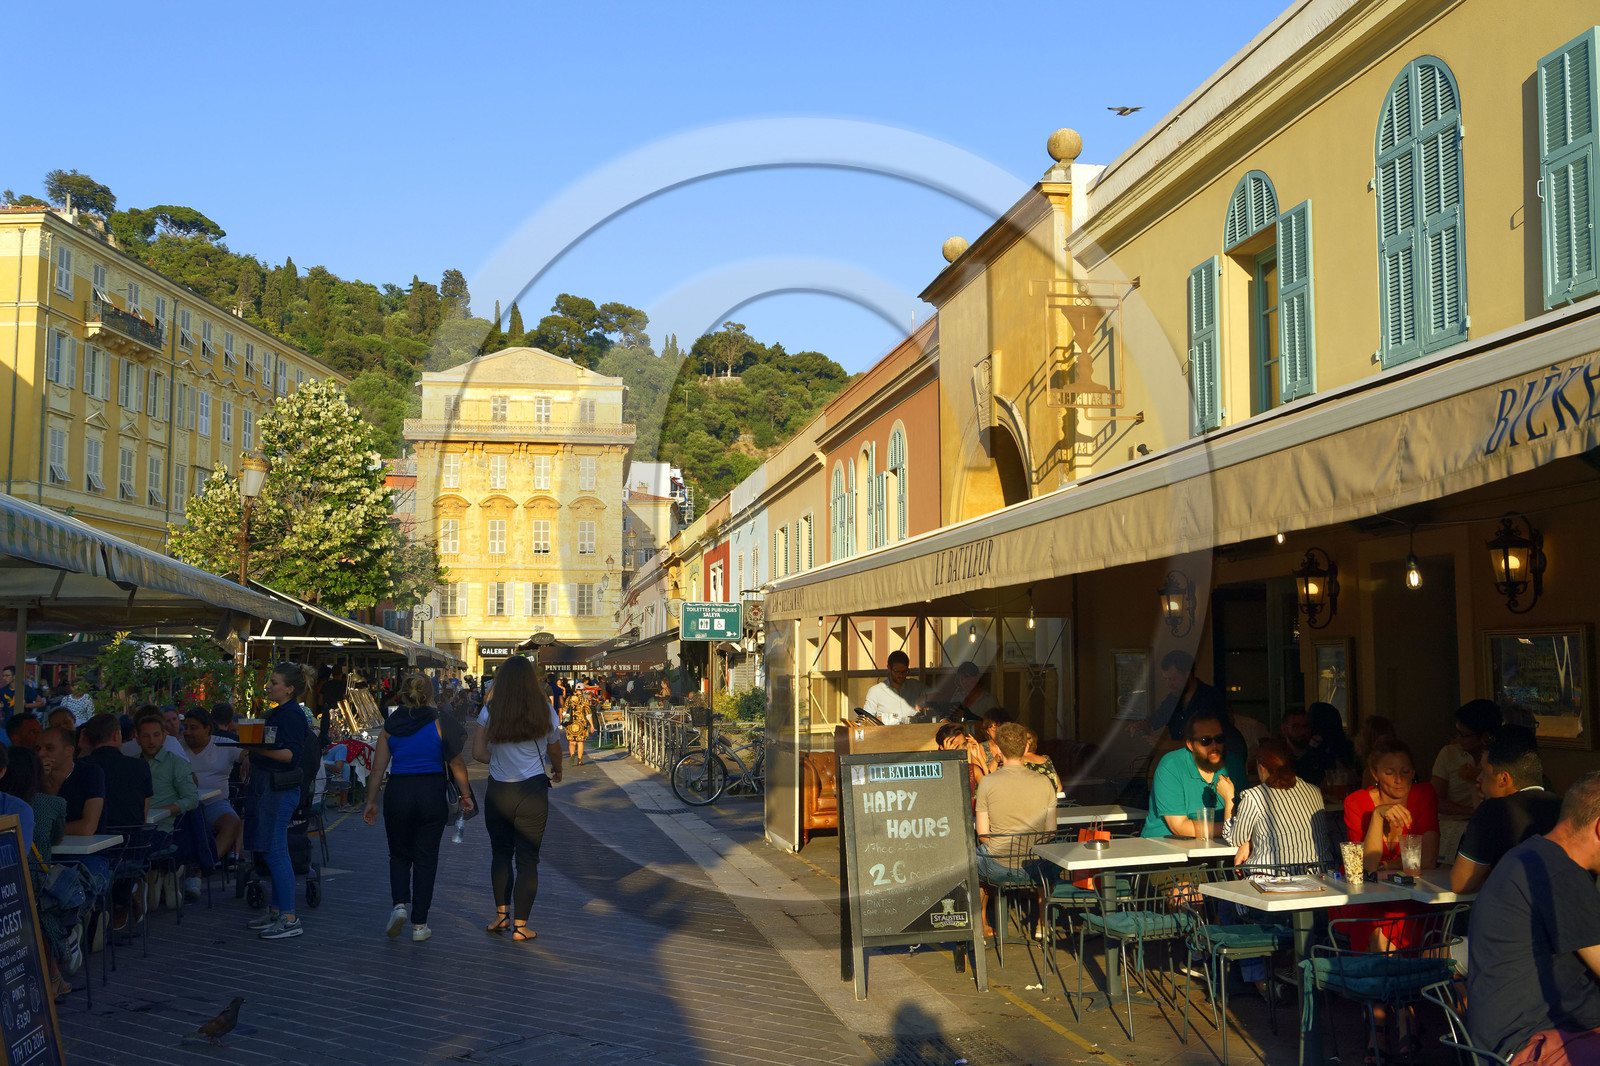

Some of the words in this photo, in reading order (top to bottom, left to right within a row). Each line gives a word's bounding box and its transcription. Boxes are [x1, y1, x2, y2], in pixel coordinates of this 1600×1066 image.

[935, 552, 946, 585] LE
[947, 539, 994, 583] BATELEUR
[874, 767, 886, 779] LE
[889, 764, 940, 779] BATELEUR
[863, 789, 918, 814] HAPPY
[886, 816, 951, 839] HOURS
[0, 882, 18, 899] HOUR
[12, 984, 26, 1002] PINTS
[32, 1030, 46, 1050] 20H
